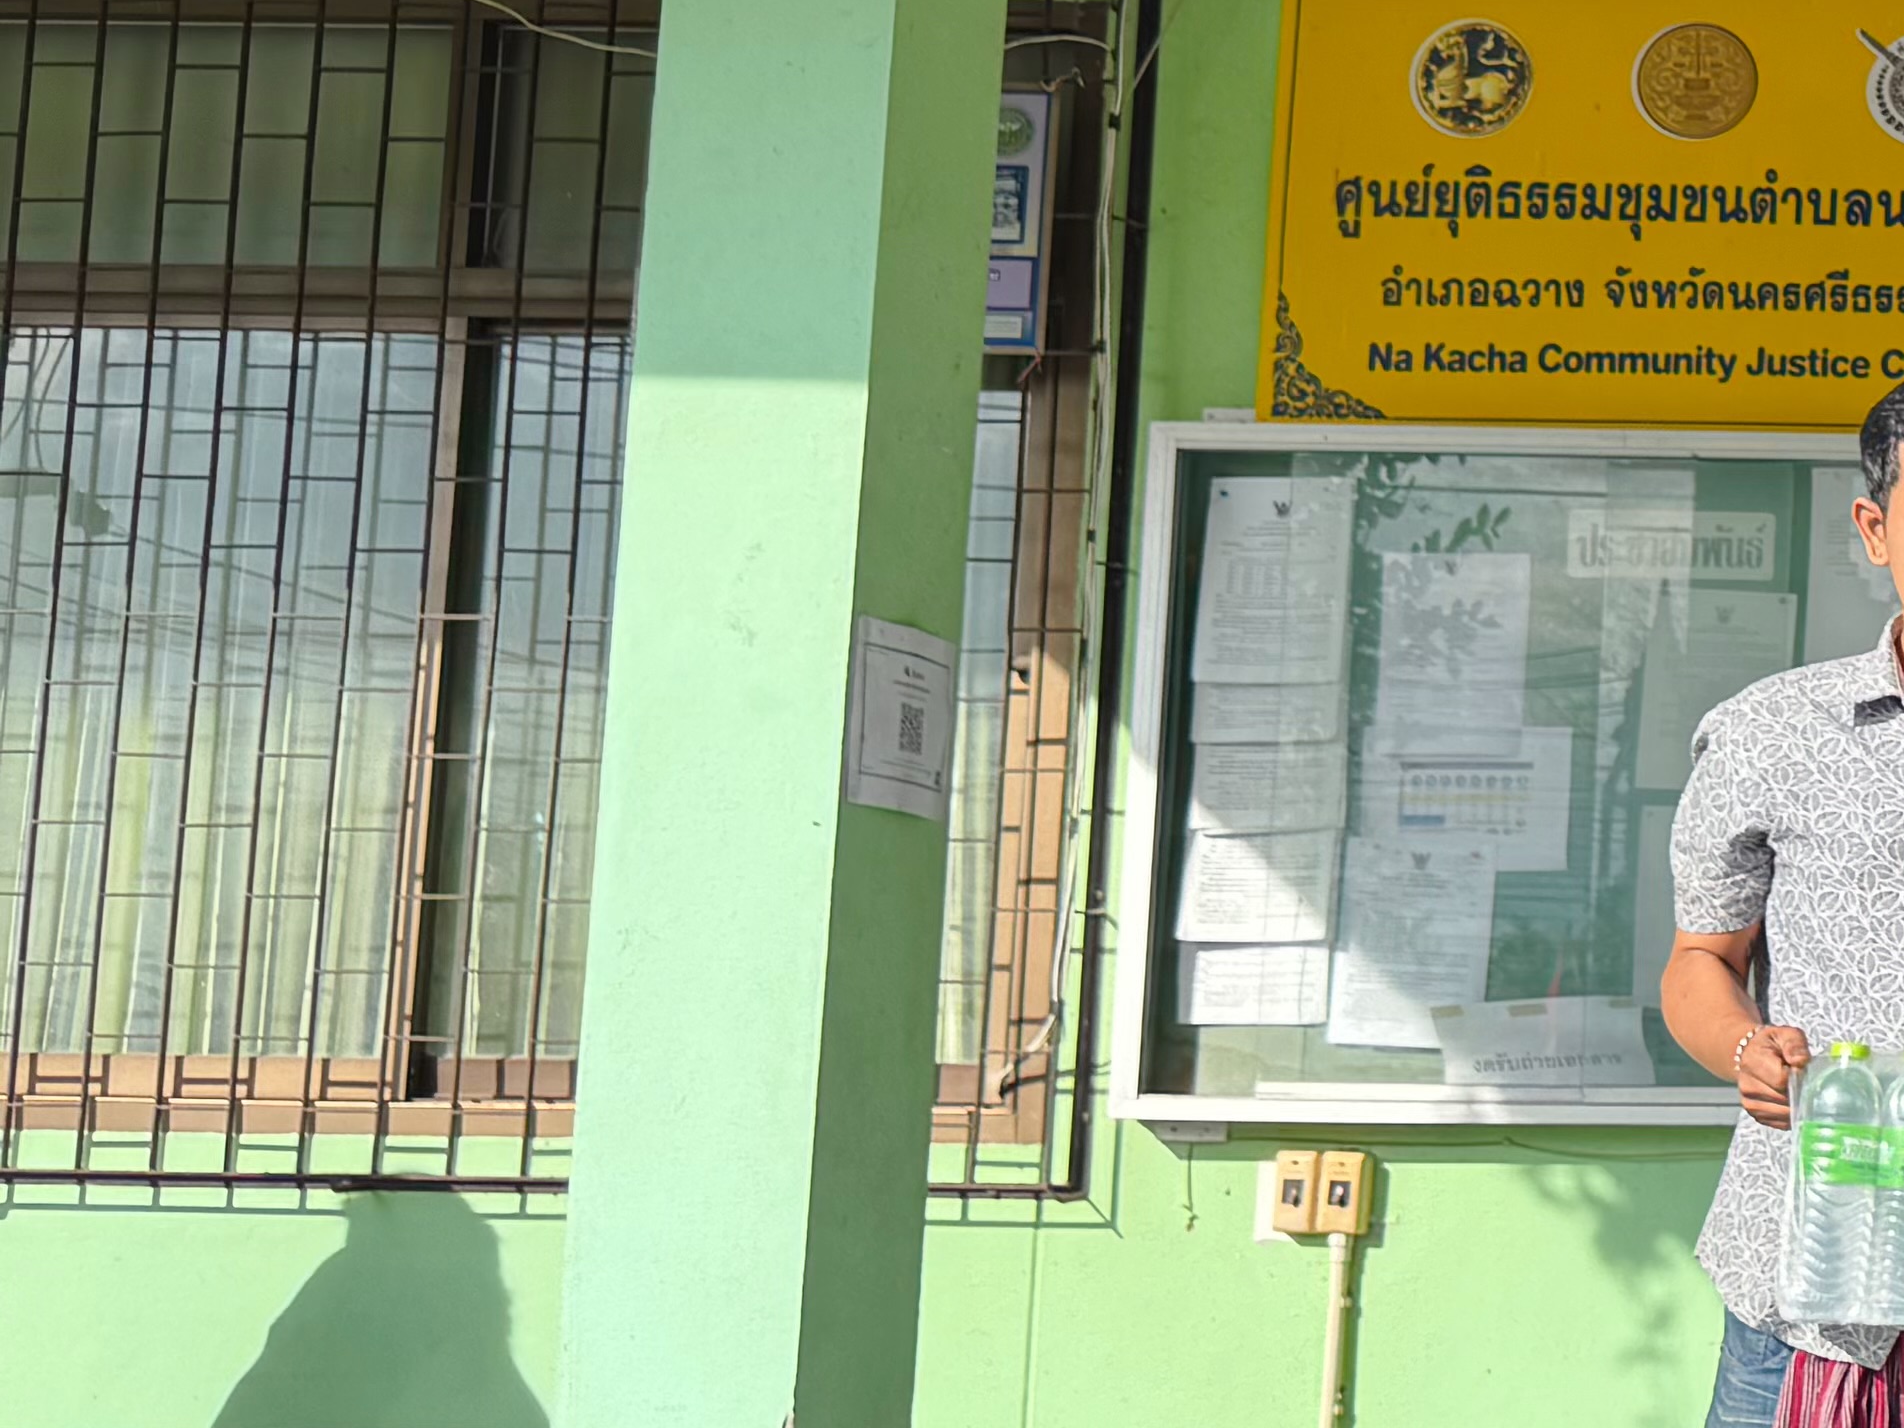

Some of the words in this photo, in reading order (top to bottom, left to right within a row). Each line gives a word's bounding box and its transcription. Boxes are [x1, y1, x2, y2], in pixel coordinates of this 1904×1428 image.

[1381, 264, 1584, 307] อำเภอฉวาง
[1368, 342, 1413, 373] Na
[1424, 342, 1527, 373] Kacha
[1538, 343, 1737, 383] Community
[1746, 346, 1870, 378] Justice
